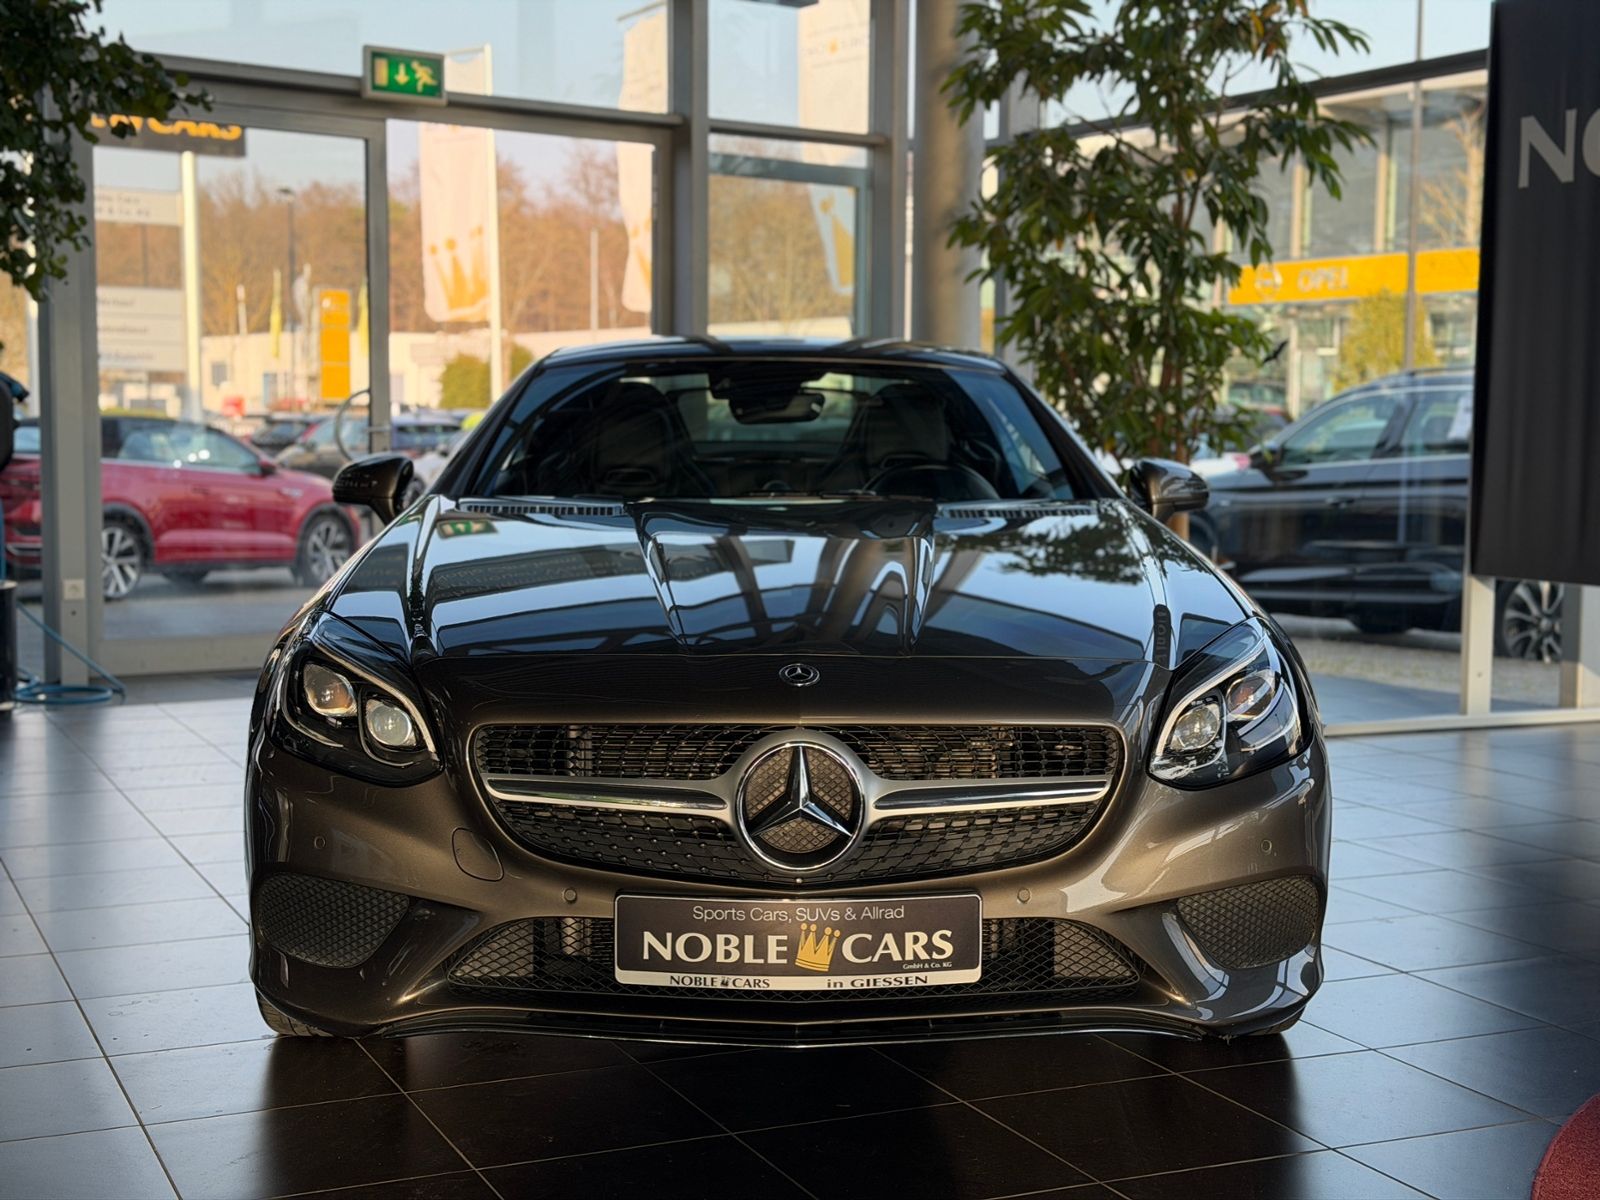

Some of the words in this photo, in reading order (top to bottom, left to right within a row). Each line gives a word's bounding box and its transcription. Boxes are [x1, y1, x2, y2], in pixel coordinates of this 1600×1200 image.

[1518, 107, 1600, 188] N
[692, 905, 746, 922] Sports
[750, 907, 792, 924] Cars,
[795, 907, 840, 922] SUVs
[844, 908, 857, 921] &
[860, 904, 905, 921] Allrad
[643, 931, 788, 964] NOBLE
[841, 929, 954, 964] CARS
[669, 975, 718, 987] NOBLE
[731, 977, 771, 989] CARS
[827, 979, 843, 988] in
[850, 975, 929, 988] GIESSEN
